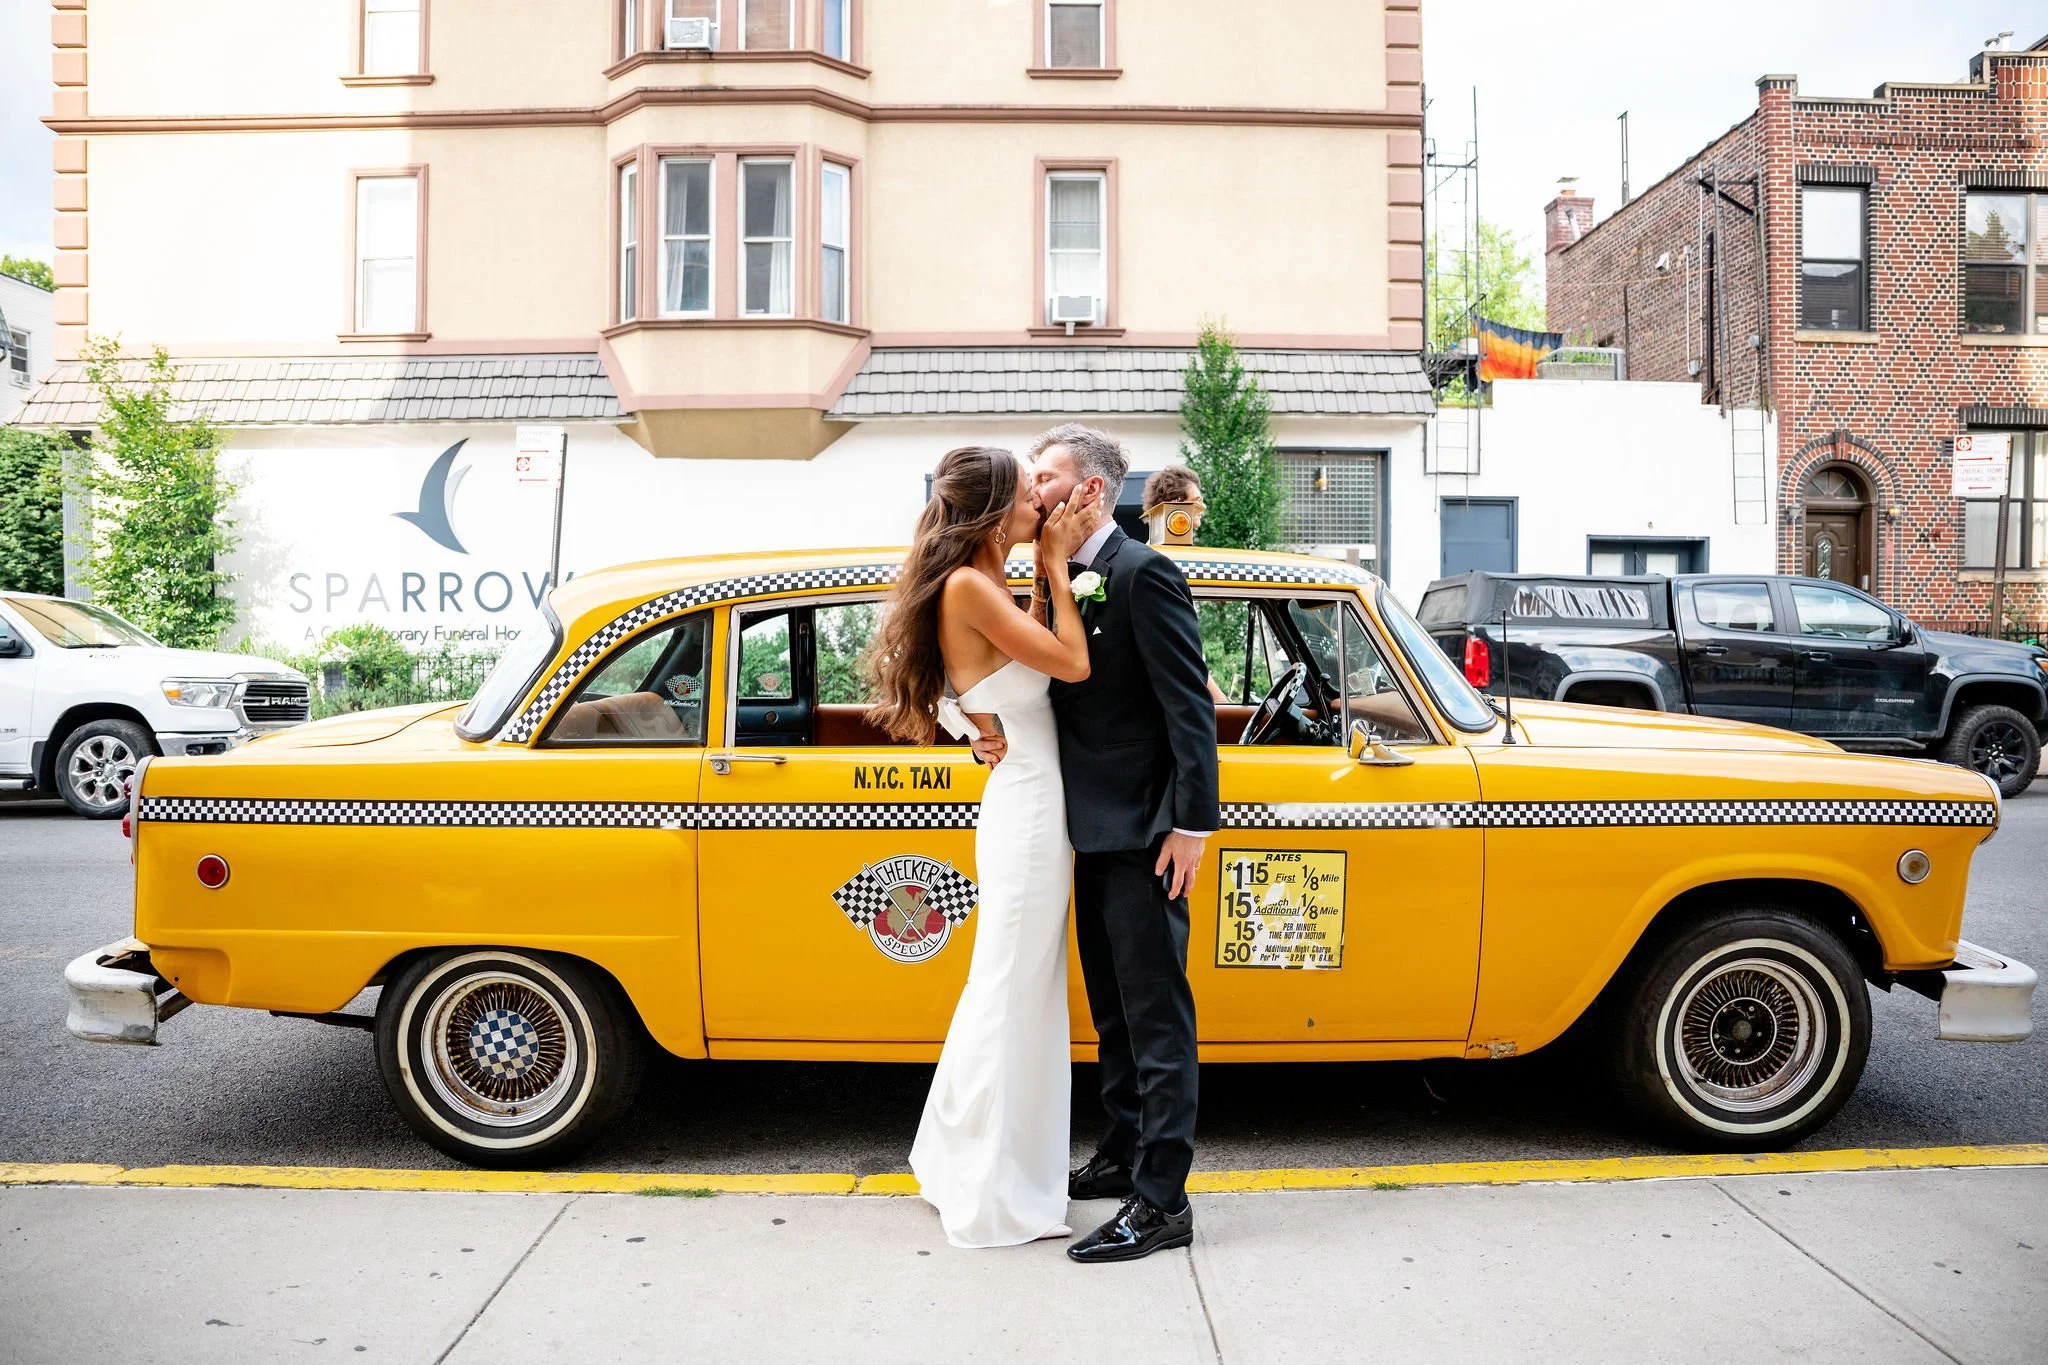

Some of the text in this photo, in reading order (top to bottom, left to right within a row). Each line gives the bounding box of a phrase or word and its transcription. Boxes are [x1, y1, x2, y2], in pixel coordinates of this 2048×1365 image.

[304, 625, 316, 640] A
[434, 625, 489, 641] Funeral
[496, 625, 520, 641] Ho
[271, 697, 301, 705] RAM
[854, 766, 951, 789] N.Y.C. TAXI
[1265, 853, 1302, 862] RATES
[875, 859, 940, 886] CHECKER
[1275, 873, 1296, 882] First
[1320, 874, 1340, 883] Mile
[1254, 905, 1300, 915] Additional
[1319, 906, 1339, 915] Mile
[1282, 922, 1294, 931] PER
[1295, 922, 1317, 931] MINUTE
[1268, 931, 1327, 940] TIME NOT IN MOTION
[884, 936, 938, 955] SPECIAL
[1264, 944, 1293, 953] Additional
[1294, 944, 1310, 955] Night
[1311, 944, 1332, 955] Charge
[1259, 953, 1271, 962] Per
